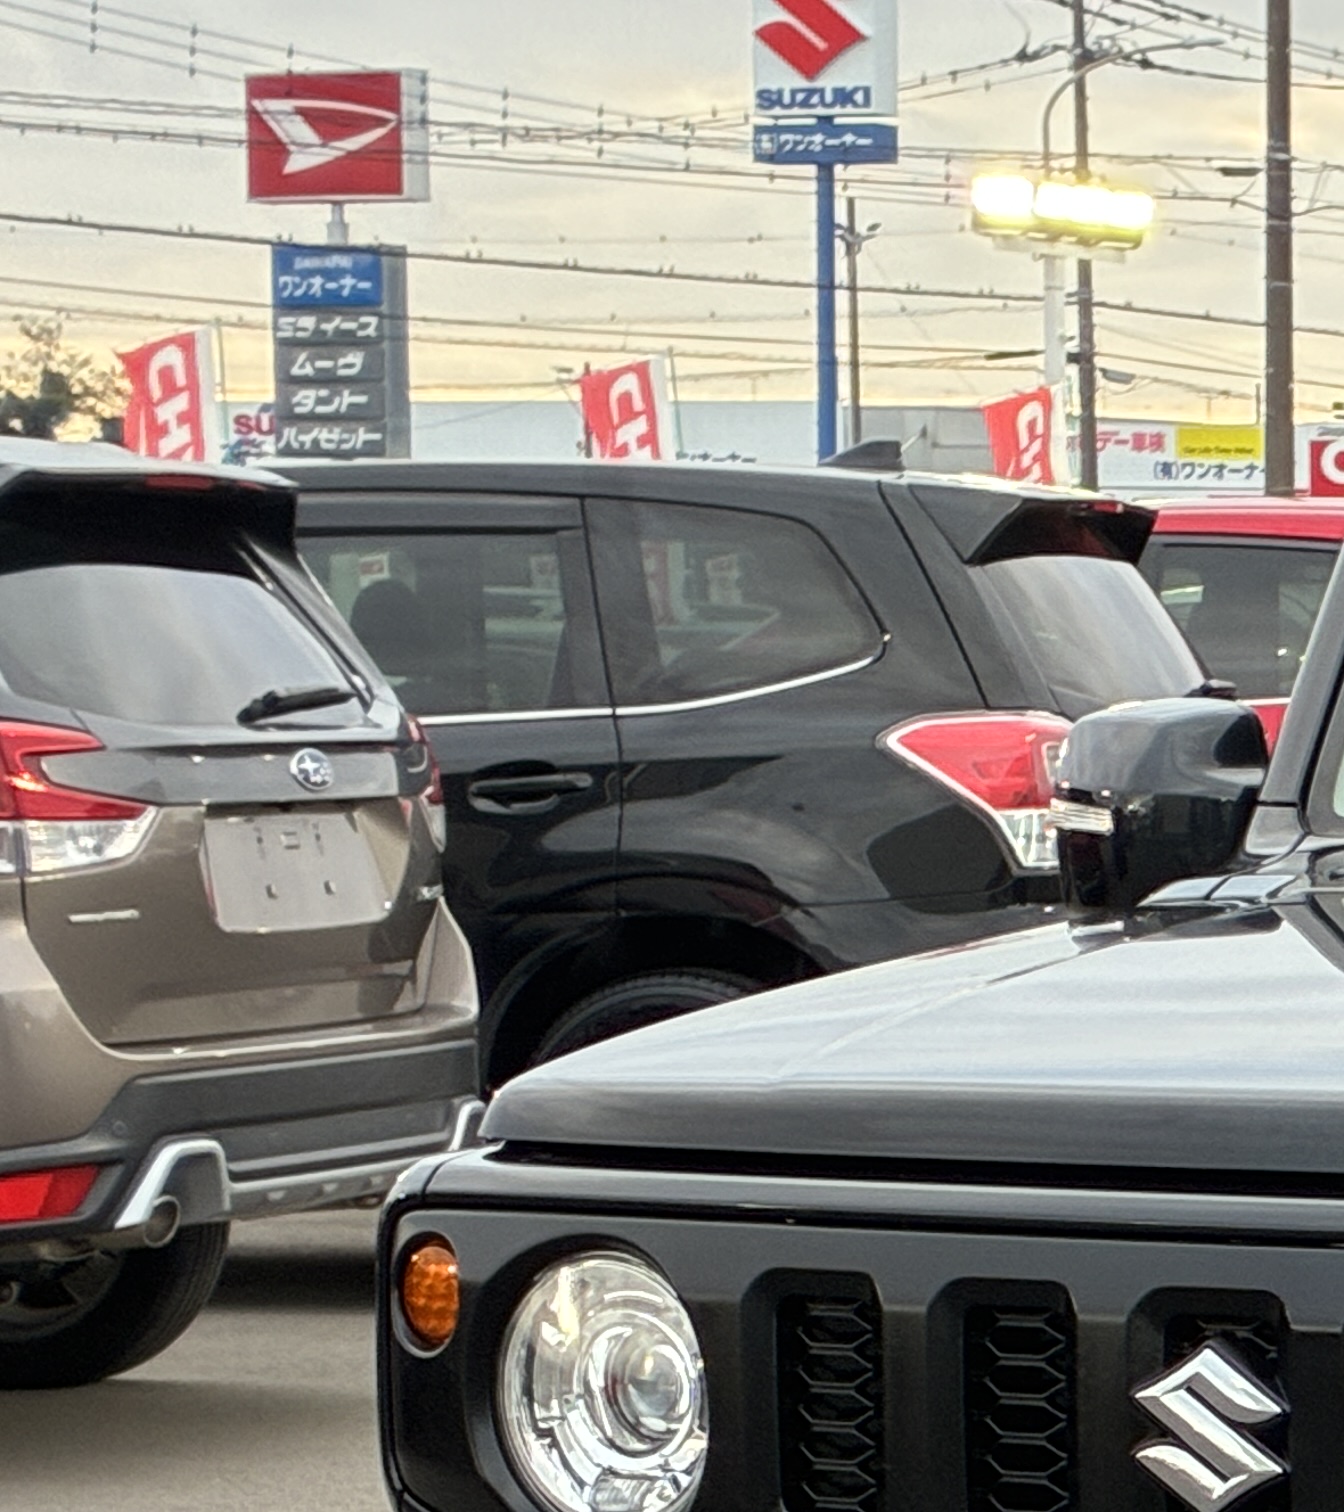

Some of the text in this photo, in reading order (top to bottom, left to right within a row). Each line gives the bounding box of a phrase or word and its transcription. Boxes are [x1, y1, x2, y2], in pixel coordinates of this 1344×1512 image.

[756, 86, 872, 110] SUZUKI
[278, 274, 373, 298] ワンオーナー
[276, 316, 379, 338] ミライース
[290, 351, 365, 376] ムーヴ
[291, 389, 369, 414] タント
[277, 426, 383, 450] ハイゼット
